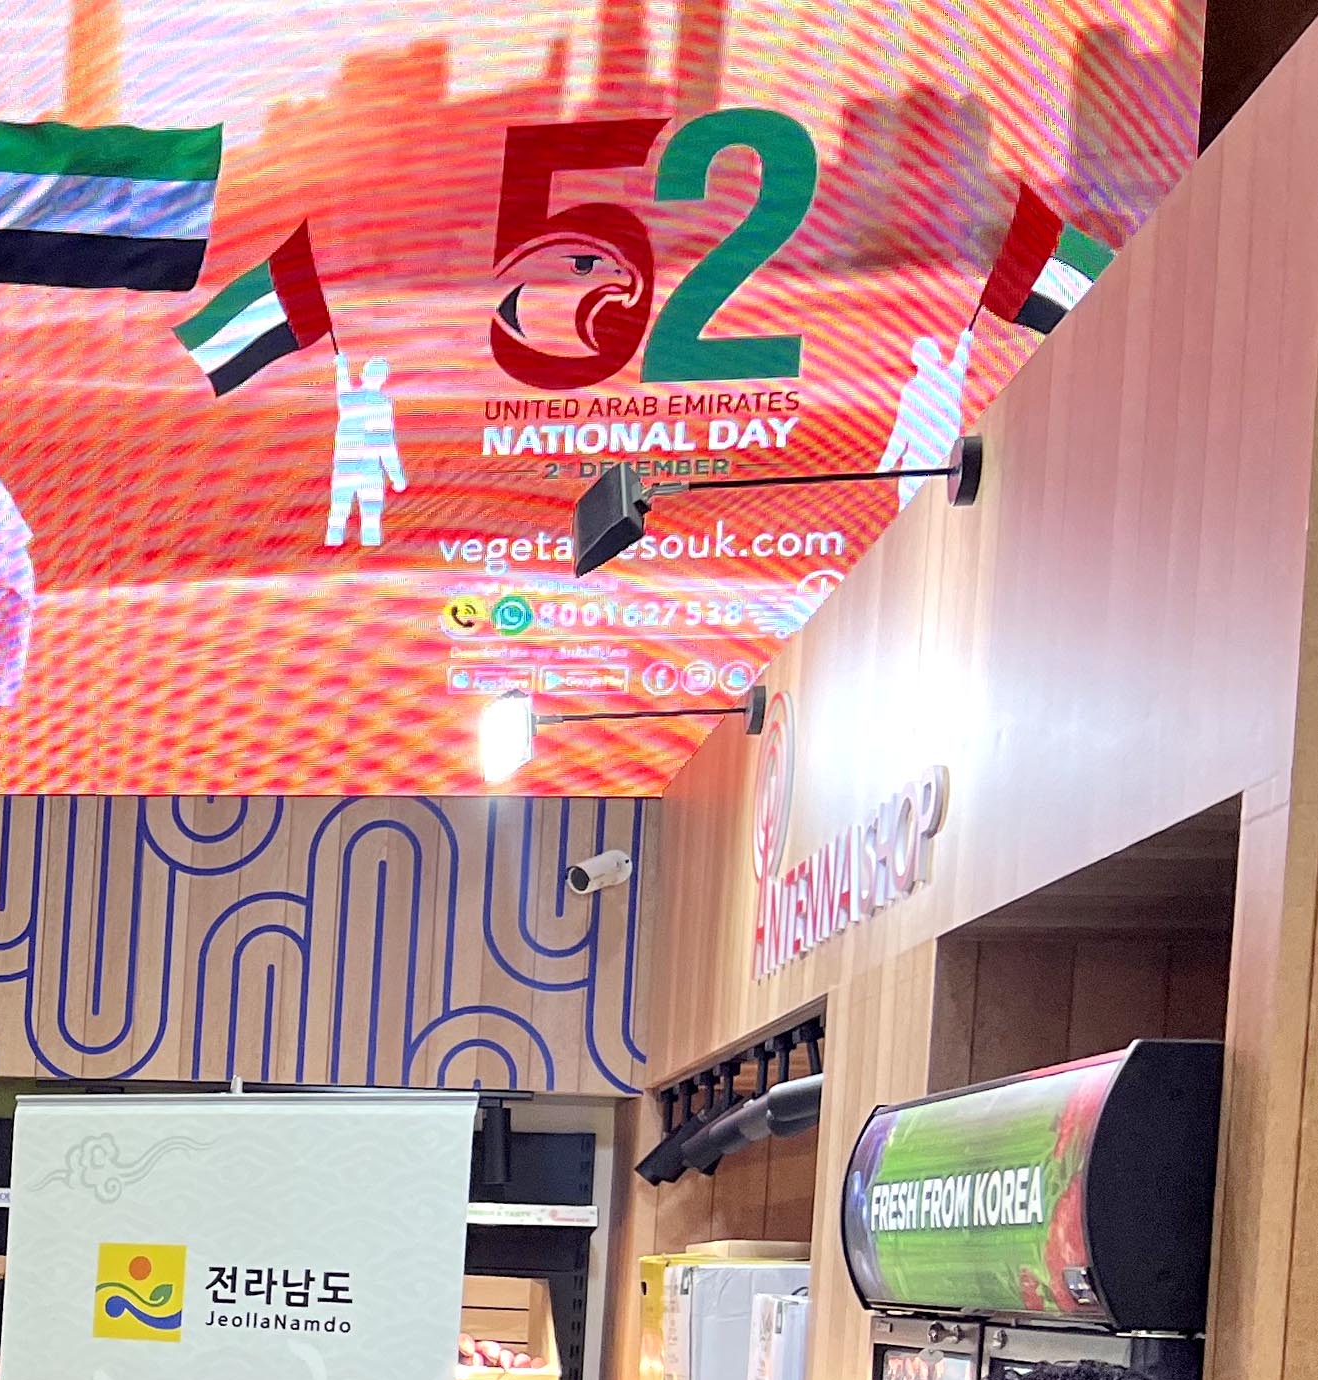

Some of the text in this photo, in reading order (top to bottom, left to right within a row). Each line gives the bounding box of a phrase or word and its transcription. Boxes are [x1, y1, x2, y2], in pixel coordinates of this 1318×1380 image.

[490, 106, 819, 390] 52
[484, 391, 801, 421] UNITED ARAB EMIRATES
[481, 416, 800, 456] NATIONAL DAY
[580, 458, 731, 477] DEEMBER
[439, 519, 845, 576] vegetasouk.com
[871, 1165, 1044, 1232] FRESH FROM KOREA
[205, 1265, 354, 1308] 전라남도
[205, 1310, 353, 1335] JeollaNamdo
